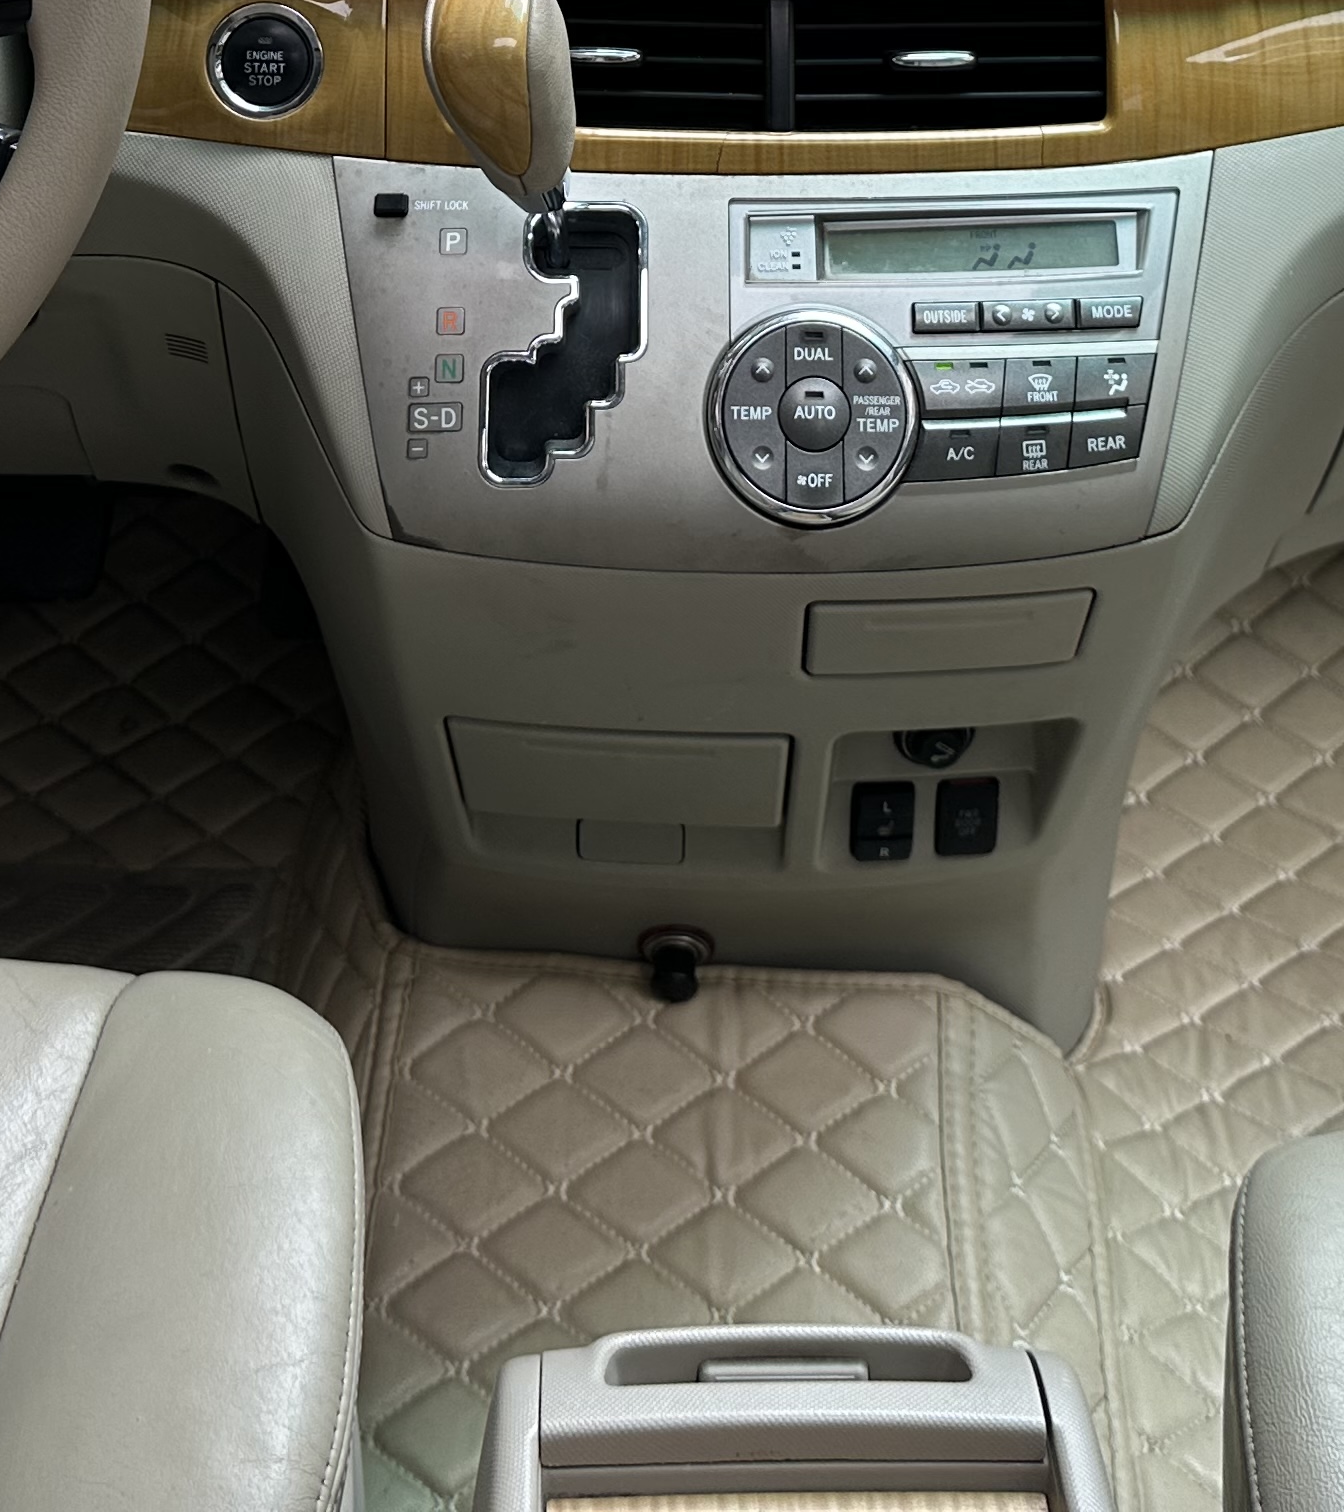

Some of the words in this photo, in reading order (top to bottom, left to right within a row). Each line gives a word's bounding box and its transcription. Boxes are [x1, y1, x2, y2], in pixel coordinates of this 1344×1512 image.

[246, 50, 284, 61] ENGINE
[243, 62, 286, 74] START
[248, 74, 282, 86] STOP
[414, 200, 441, 211] SHIFT
[444, 200, 469, 211] LOCK
[445, 231, 461, 252] P
[769, 248, 788, 259] ION
[756, 261, 789, 273] CLEAN
[923, 309, 967, 324] OUTSIDE
[1091, 304, 1133, 319] MODE
[442, 311, 458, 331] R
[793, 347, 834, 361] DUAL
[442, 359, 457, 378] N
[853, 395, 901, 406] PASSENGER
[1027, 390, 1058, 402] FRONT
[413, 407, 457, 429] S-D
[730, 406, 773, 420] TEMP
[793, 405, 836, 420] AUTO
[864, 407, 891, 416] /REAR
[856, 418, 900, 433] TEMP
[1087, 435, 1126, 452] REAR
[946, 446, 975, 461] A/C
[1022, 459, 1048, 470] REAR
[807, 473, 834, 488] OFF
